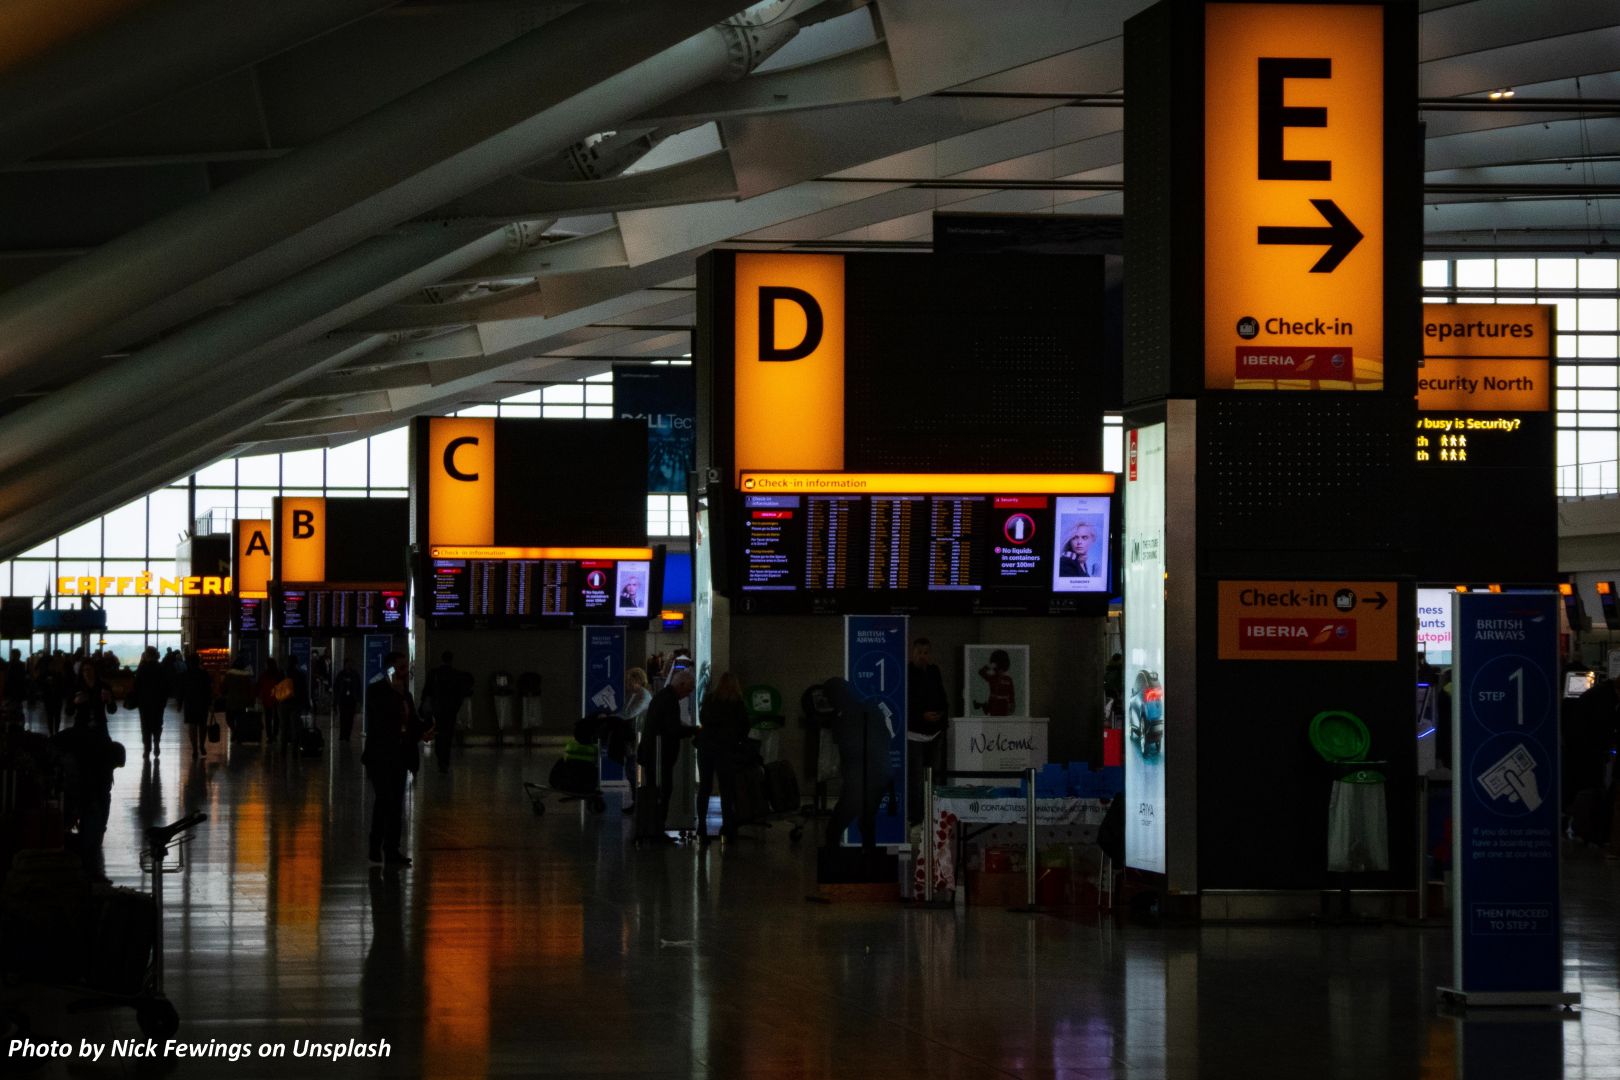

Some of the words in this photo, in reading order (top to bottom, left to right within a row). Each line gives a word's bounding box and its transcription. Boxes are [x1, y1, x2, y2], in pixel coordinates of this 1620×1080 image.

[1258, 57, 1332, 181] E
[758, 286, 824, 361] D
[1265, 317, 1353, 335] Check-in
[1425, 320, 1534, 342] epartures
[1242, 355, 1295, 366] IBERIA
[1418, 376, 1478, 394] ecurity
[1483, 376, 1534, 391] North
[1424, 418, 1452, 431] busy
[1455, 418, 1465, 429] is
[1466, 418, 1521, 432] Security?
[443, 436, 479, 482] C
[758, 479, 803, 488] Check-in
[805, 478, 867, 488] information
[292, 509, 315, 539] B
[245, 530, 270, 556] A
[1012, 547, 1032, 555] liquids
[1239, 589, 1328, 607] Check-in
[1418, 607, 1444, 615] ness
[1247, 625, 1309, 638] IBERIA
[1421, 619, 1446, 628] unts
[1476, 618, 1524, 630] BRITISH
[1474, 630, 1526, 641] AIRWAYS
[875, 658, 885, 692] 1
[1477, 691, 1506, 702] STEP
[1508, 666, 1524, 726] 1
[970, 733, 1034, 753] Welcome
[1475, 908, 1504, 918] THEN
[1505, 908, 1550, 919] PROCEED
[1490, 920, 1504, 930] TO
[1506, 920, 1529, 930] STEP
